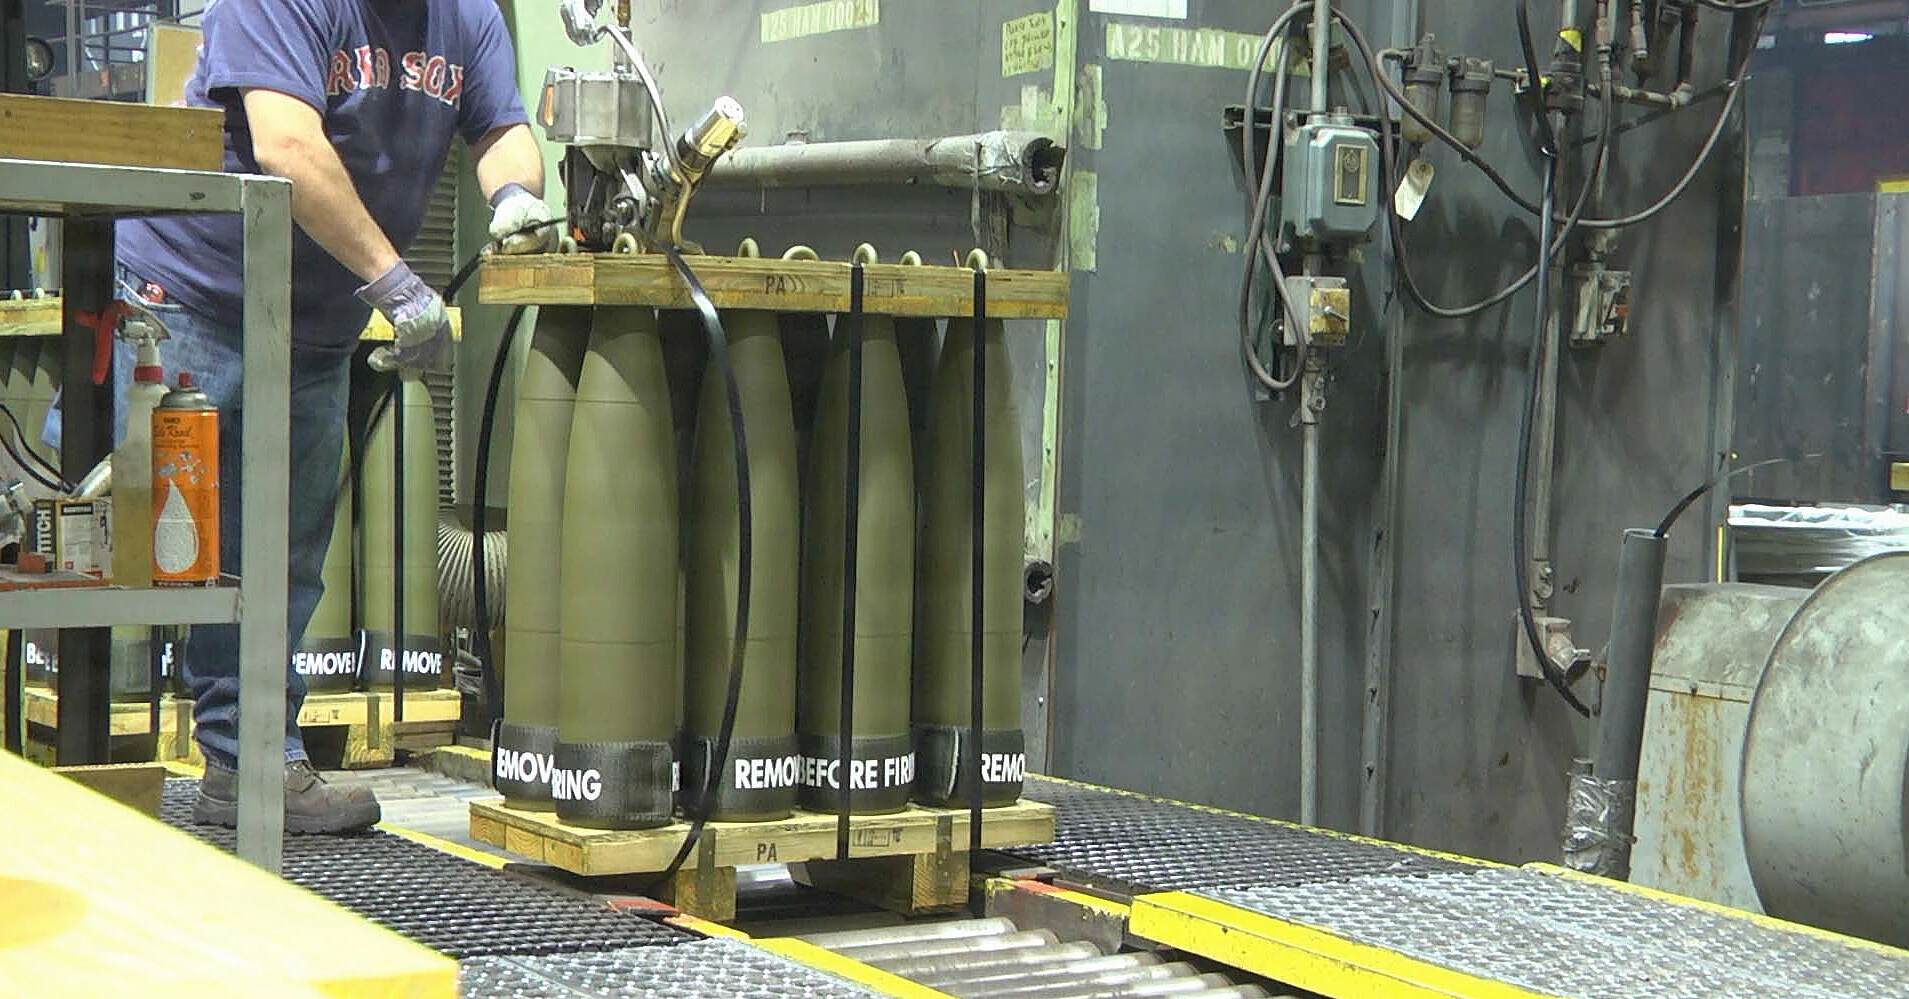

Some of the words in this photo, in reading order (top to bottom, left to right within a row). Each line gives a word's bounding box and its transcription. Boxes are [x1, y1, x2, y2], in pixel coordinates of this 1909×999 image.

[1110, 23, 1161, 58] A25
[1171, 30, 1225, 66] HAM
[293, 651, 351, 675] EMOVE
[756, 842, 778, 862] PA
